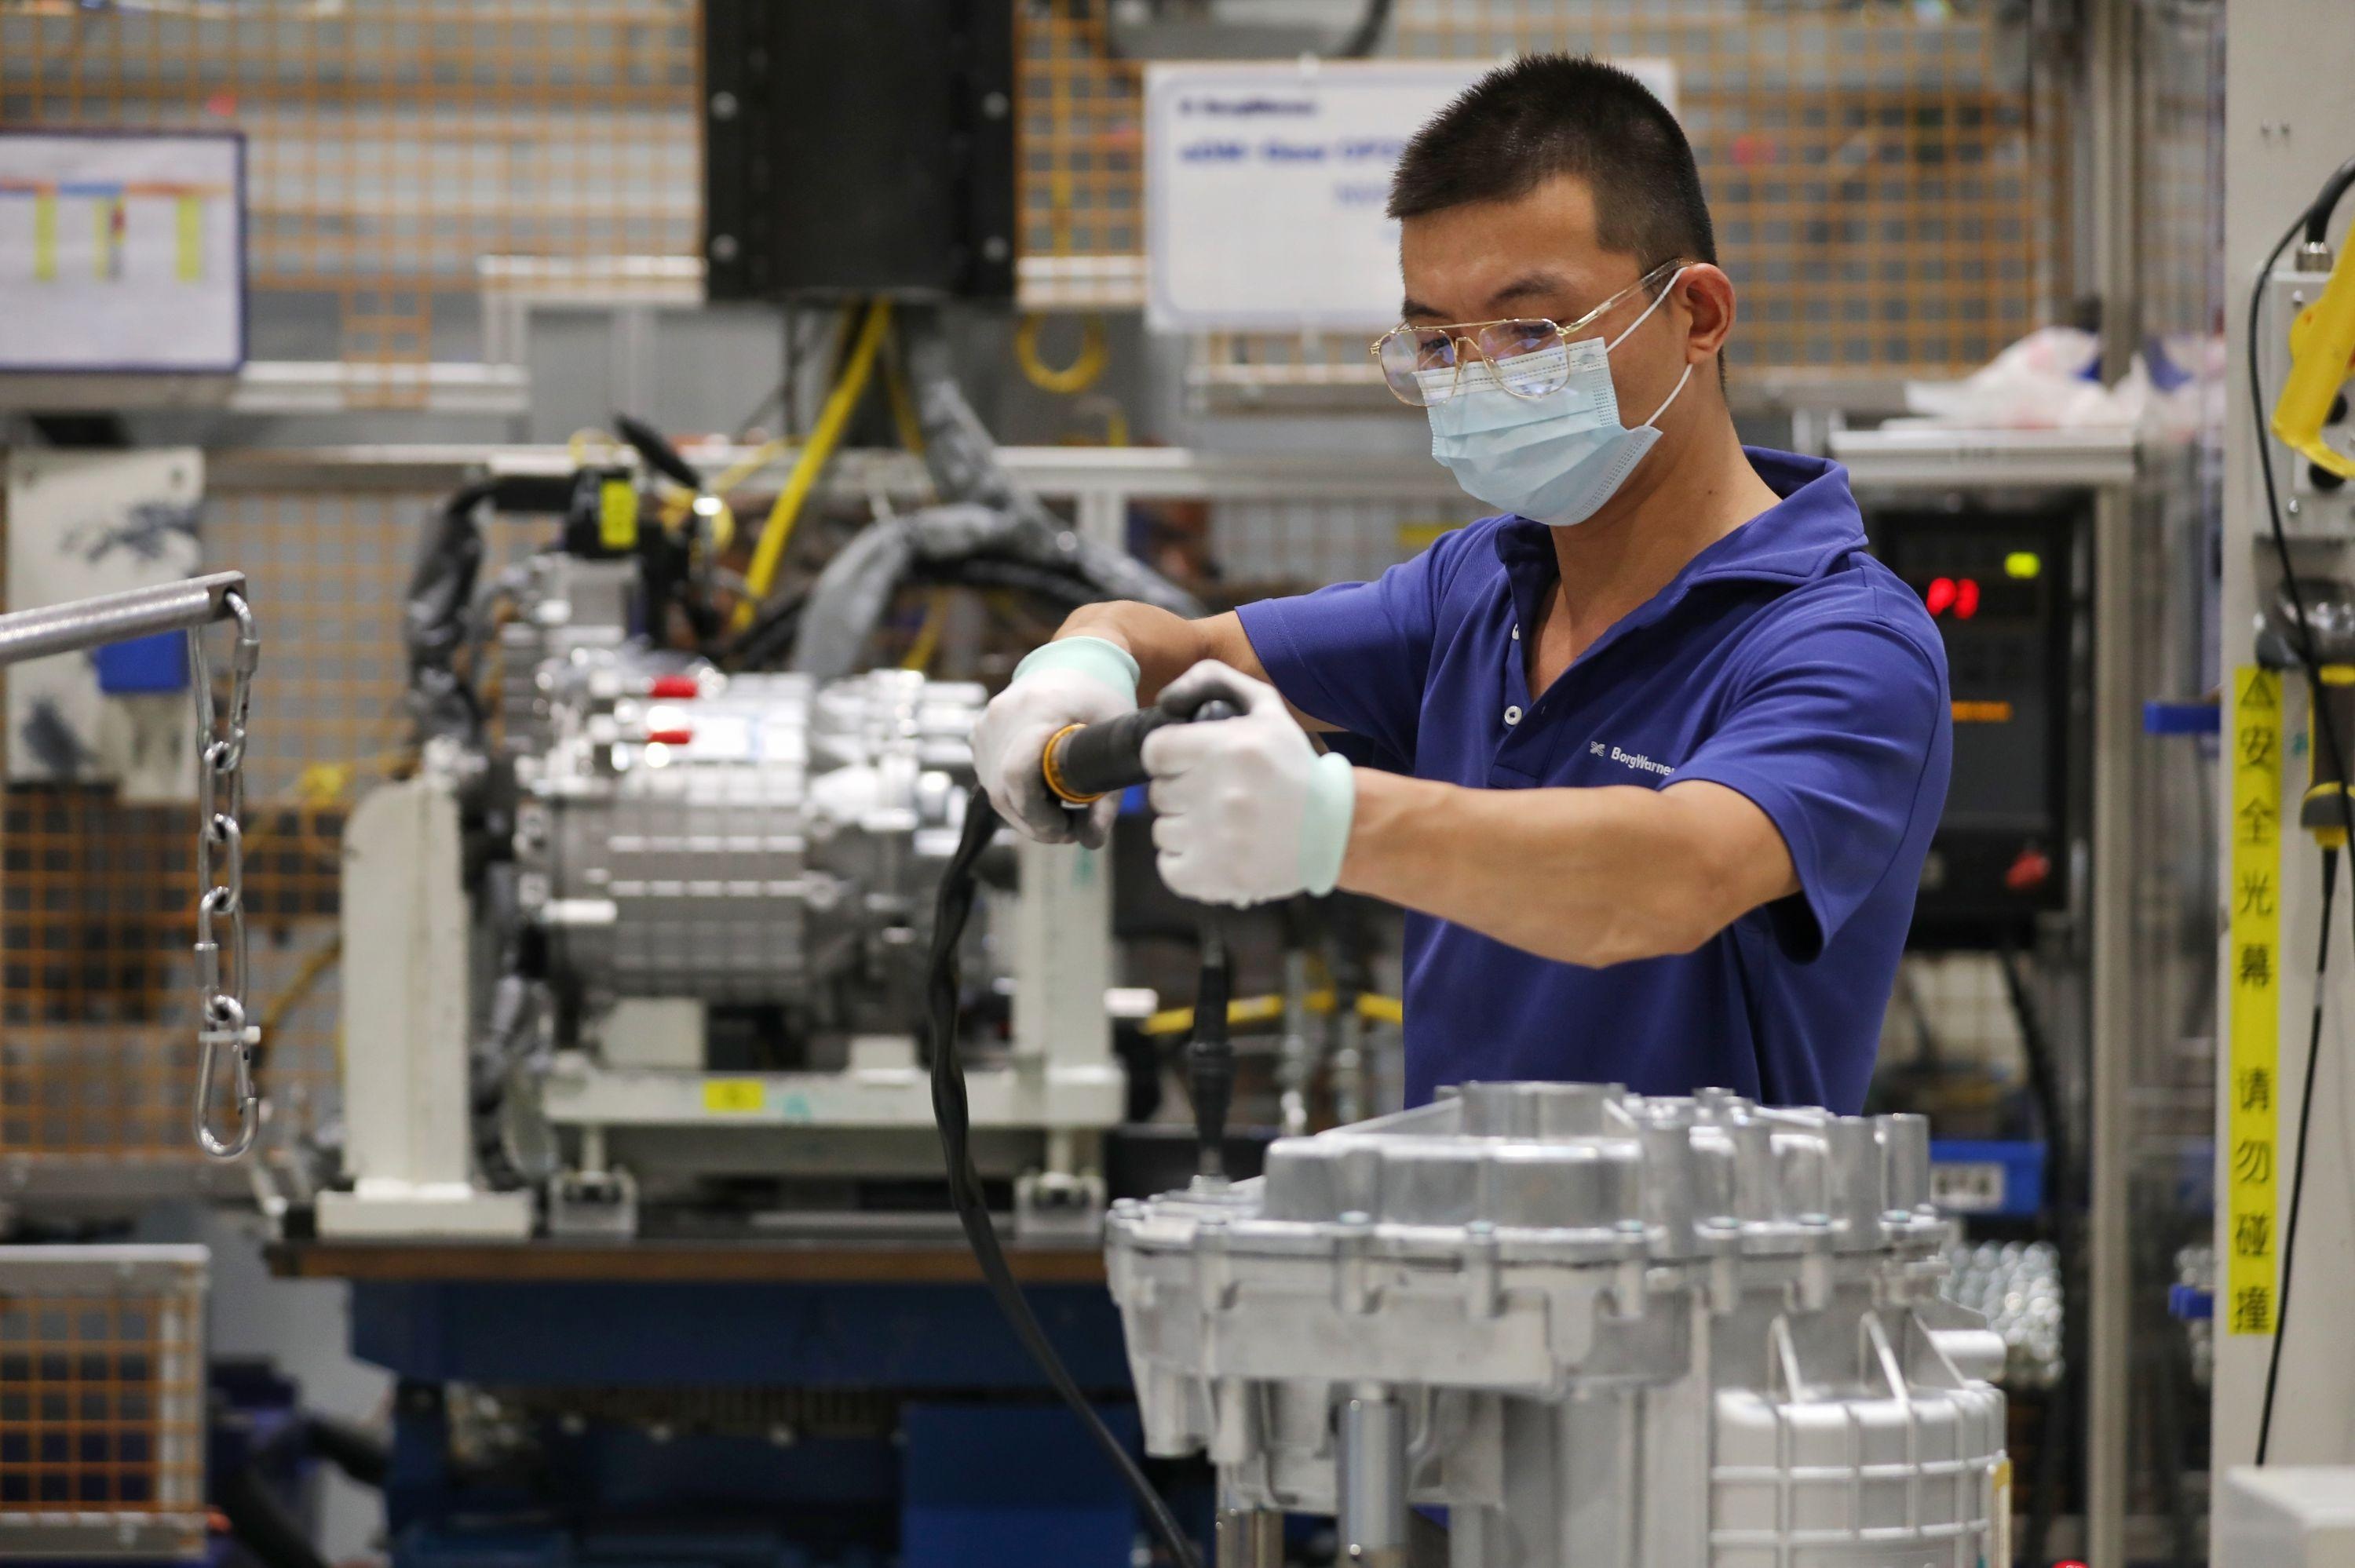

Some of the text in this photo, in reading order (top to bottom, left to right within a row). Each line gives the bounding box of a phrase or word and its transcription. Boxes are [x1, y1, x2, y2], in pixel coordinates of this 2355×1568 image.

[2236, 724, 2273, 1332] 安全光幕 请勿碰撞
